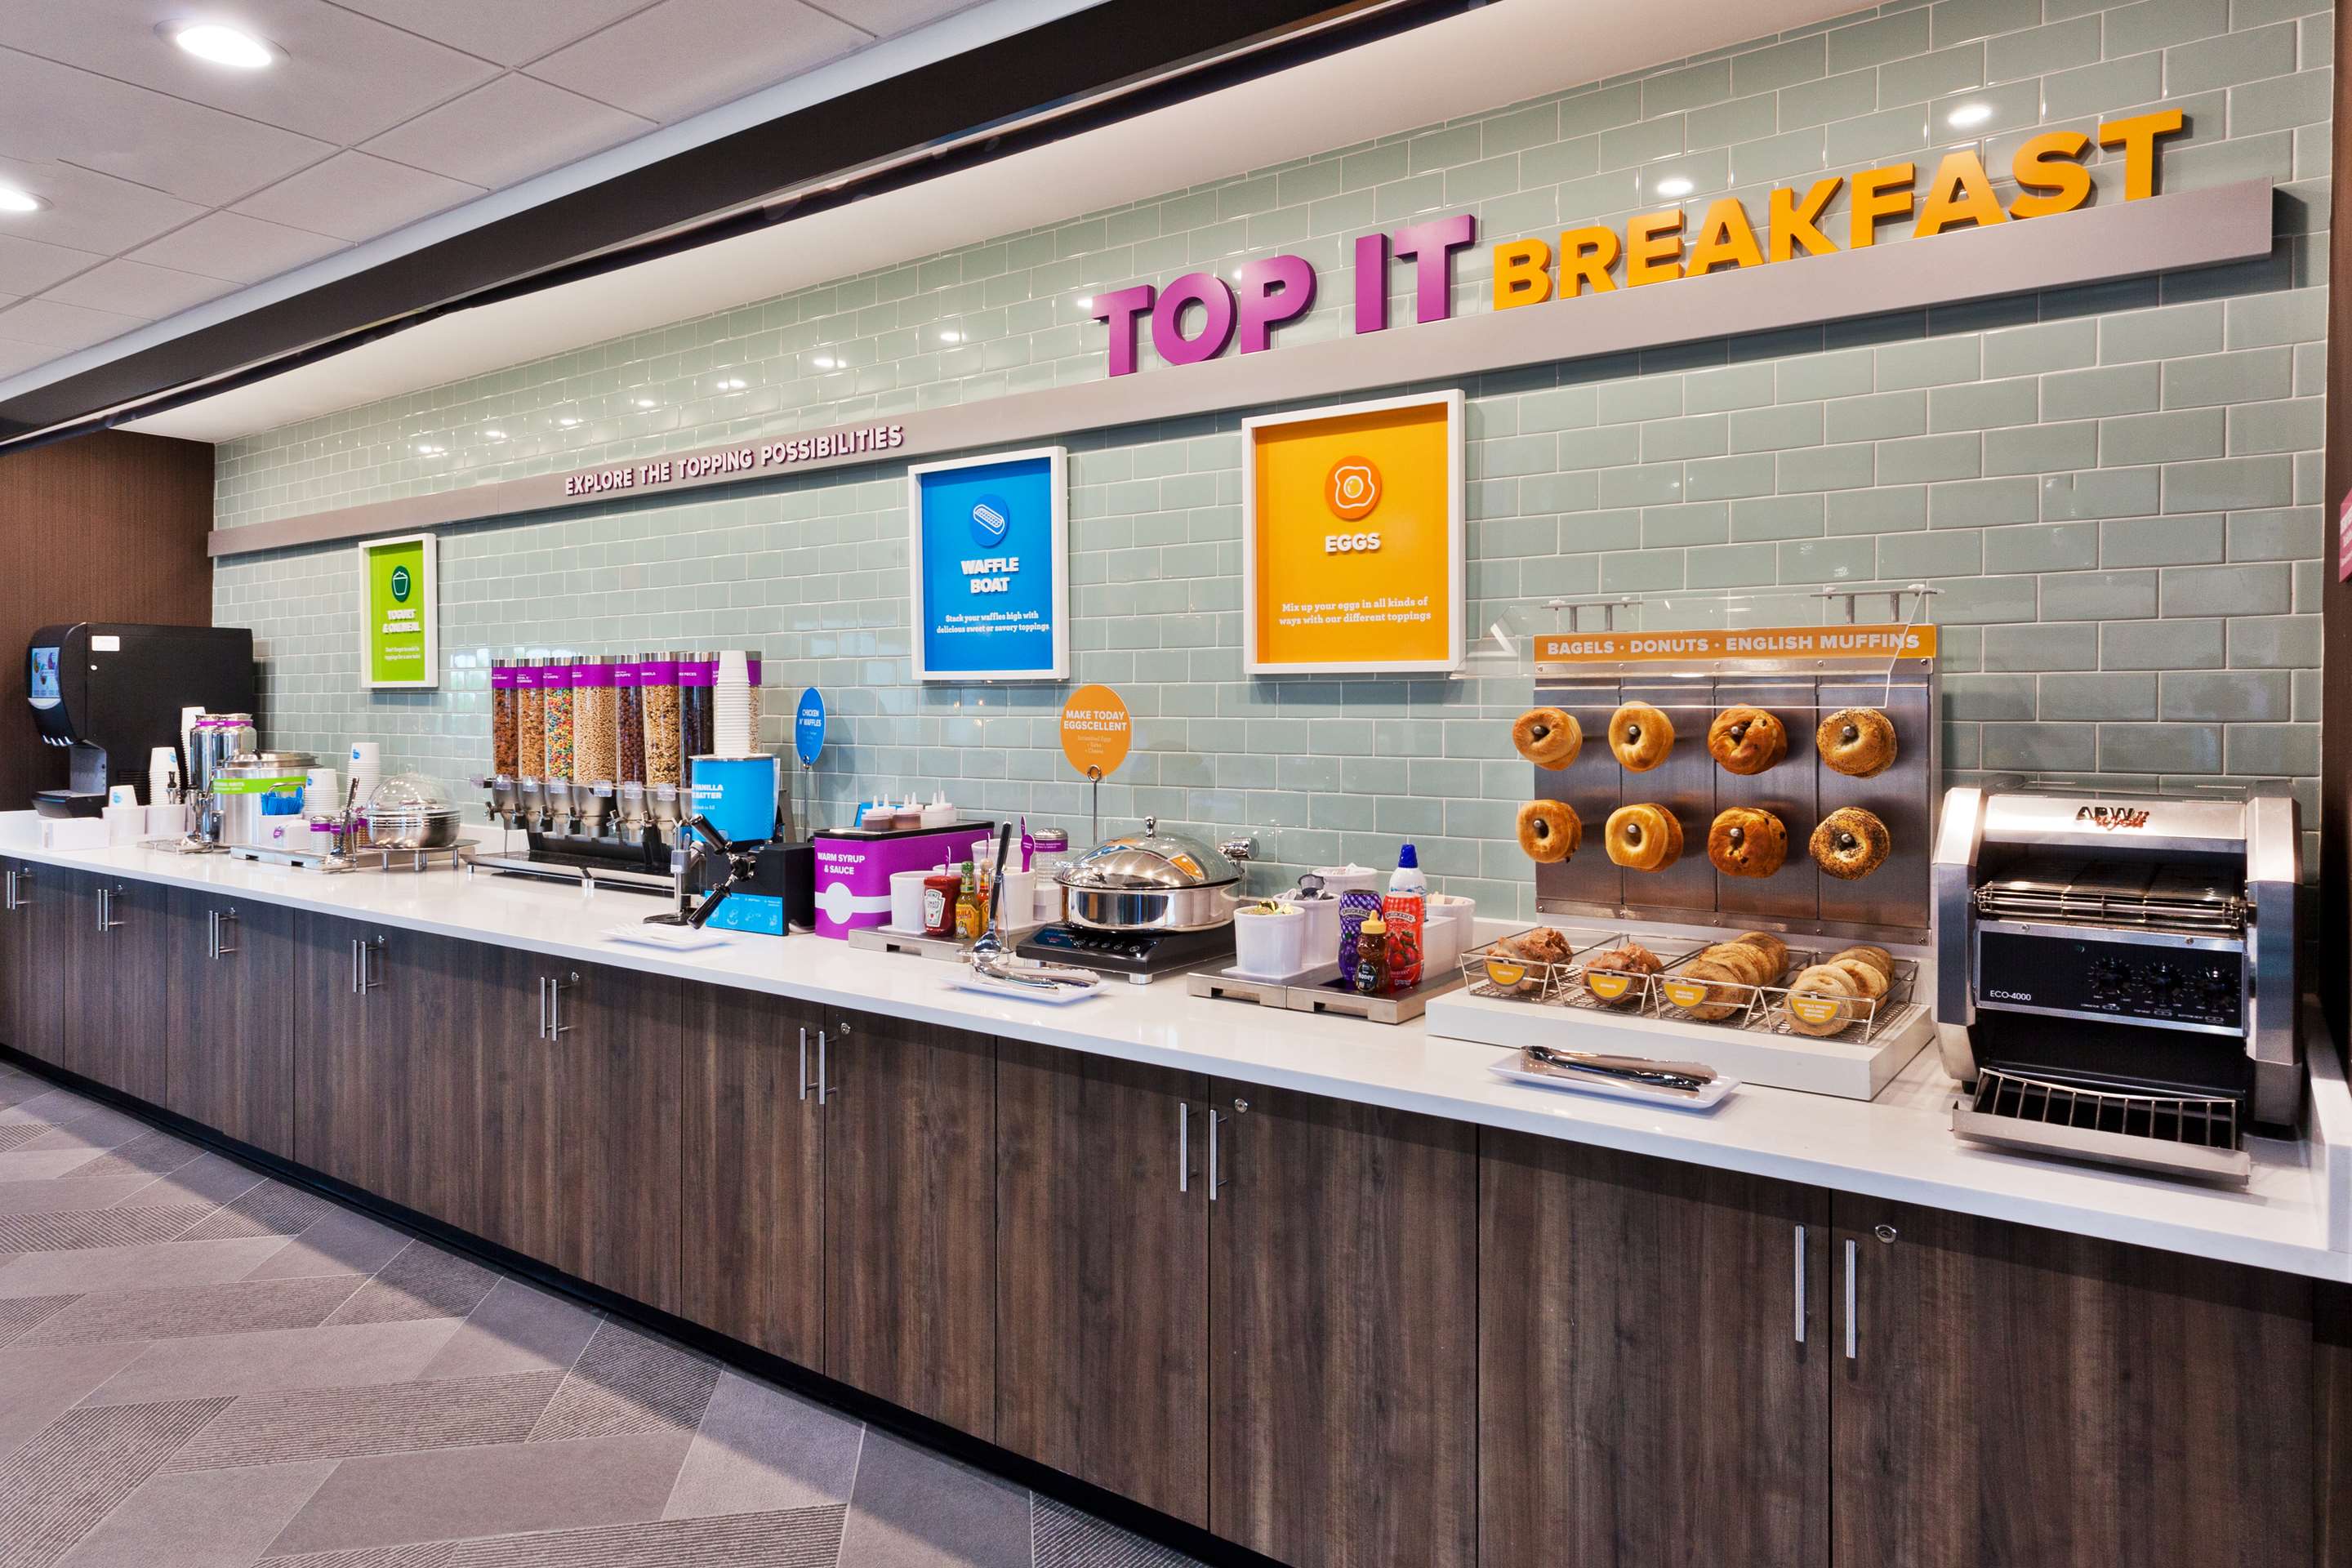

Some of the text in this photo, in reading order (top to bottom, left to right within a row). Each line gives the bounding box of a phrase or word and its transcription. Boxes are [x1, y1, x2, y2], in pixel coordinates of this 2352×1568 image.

[1493, 108, 2184, 312] BREAKFAST
[1093, 214, 1476, 378] TOP IT
[565, 425, 904, 496] EXPLORE THE TOPPING POSSIBILITIES
[1325, 532, 1382, 553] EGGS
[960, 557, 1020, 575] WAFFLE
[970, 577, 1010, 594] BOAT
[1281, 596, 1429, 613] Mix up your eggs in all kinds of
[945, 610, 1039, 624] Stack your waffles high with
[1279, 611, 1432, 627] ways with our different toppings
[937, 625, 966, 634] delicious
[995, 624, 1018, 633] savory
[1018, 622, 1050, 632] toppings
[1548, 633, 1921, 655] BAGELS DONUTS ENGLISH MUFFINS
[1066, 710, 1125, 720] MAKE TODAY
[1063, 720, 1128, 732] EGGSCELLENT
[817, 852, 866, 863] WARM SYRUP
[824, 864, 854, 875] & SAUCE
[1358, 972, 1374, 982] Honey
[1989, 990, 2032, 1001] ECO-4000
